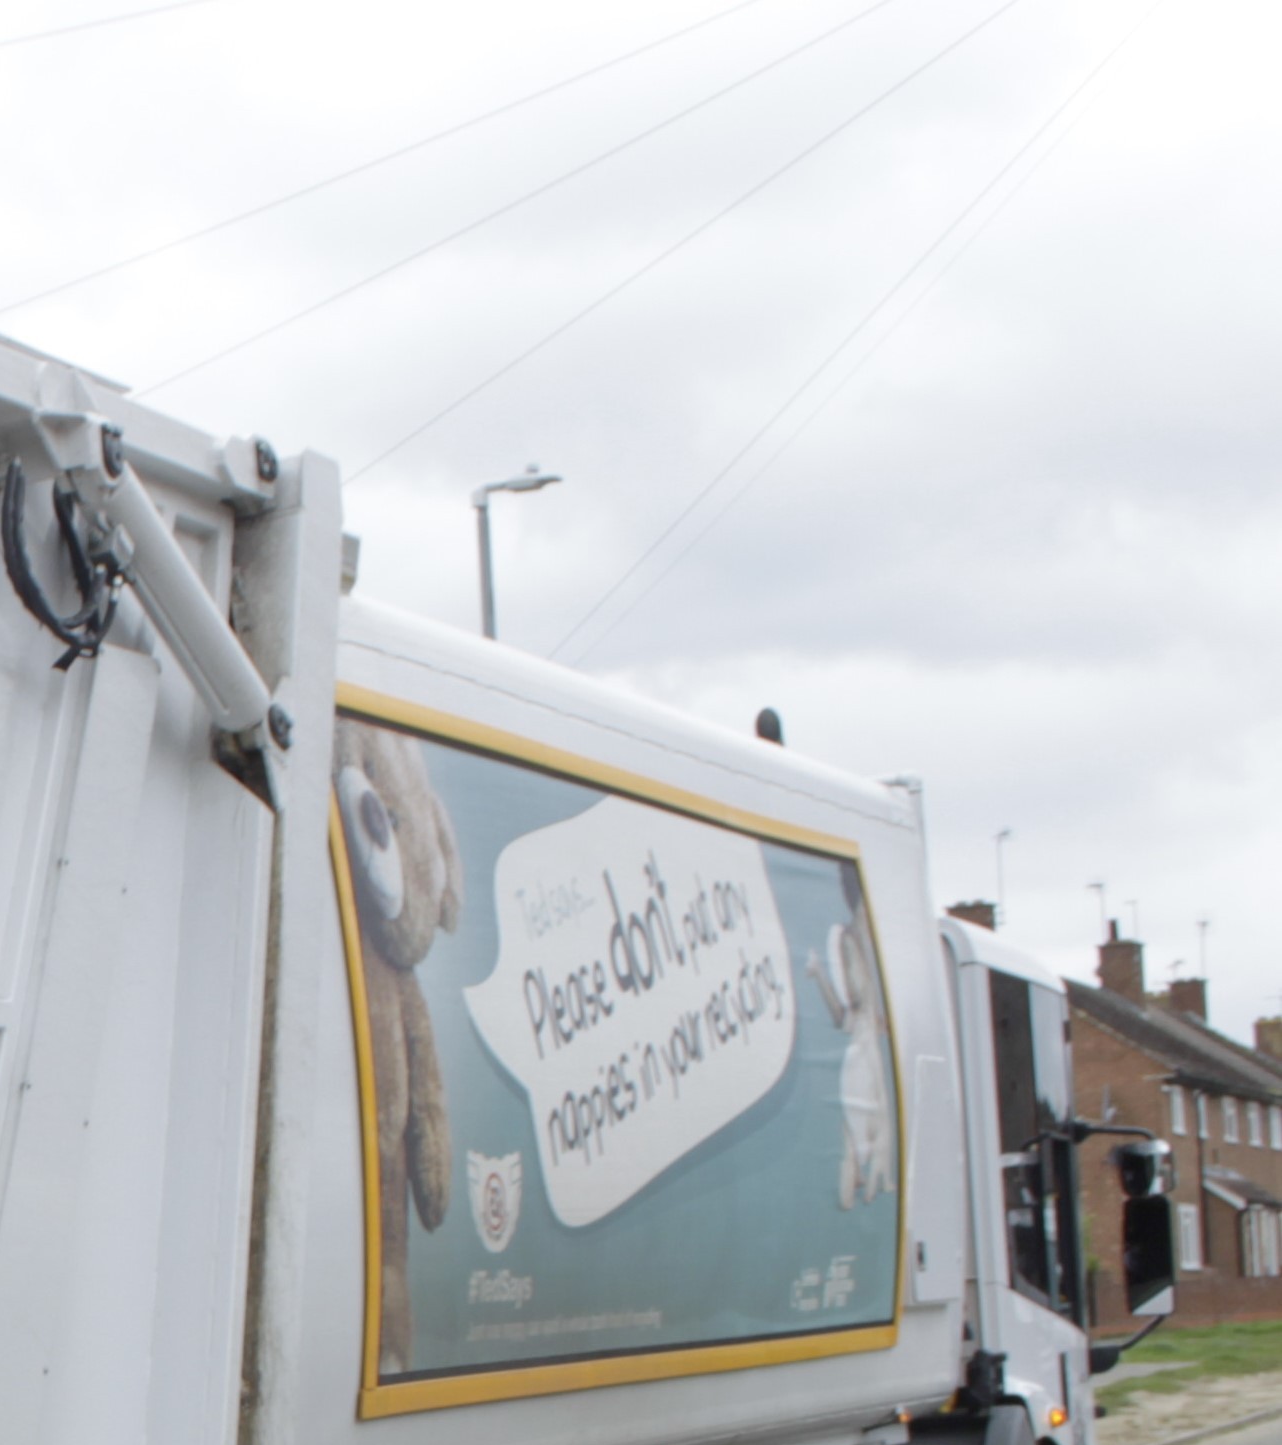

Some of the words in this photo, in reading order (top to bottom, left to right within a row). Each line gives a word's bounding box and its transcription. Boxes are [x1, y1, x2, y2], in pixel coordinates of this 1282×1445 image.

[524, 957, 615, 1061] Please
[602, 848, 685, 998] don't
[548, 1052, 637, 1167] nappies
[633, 1041, 662, 1101] in
